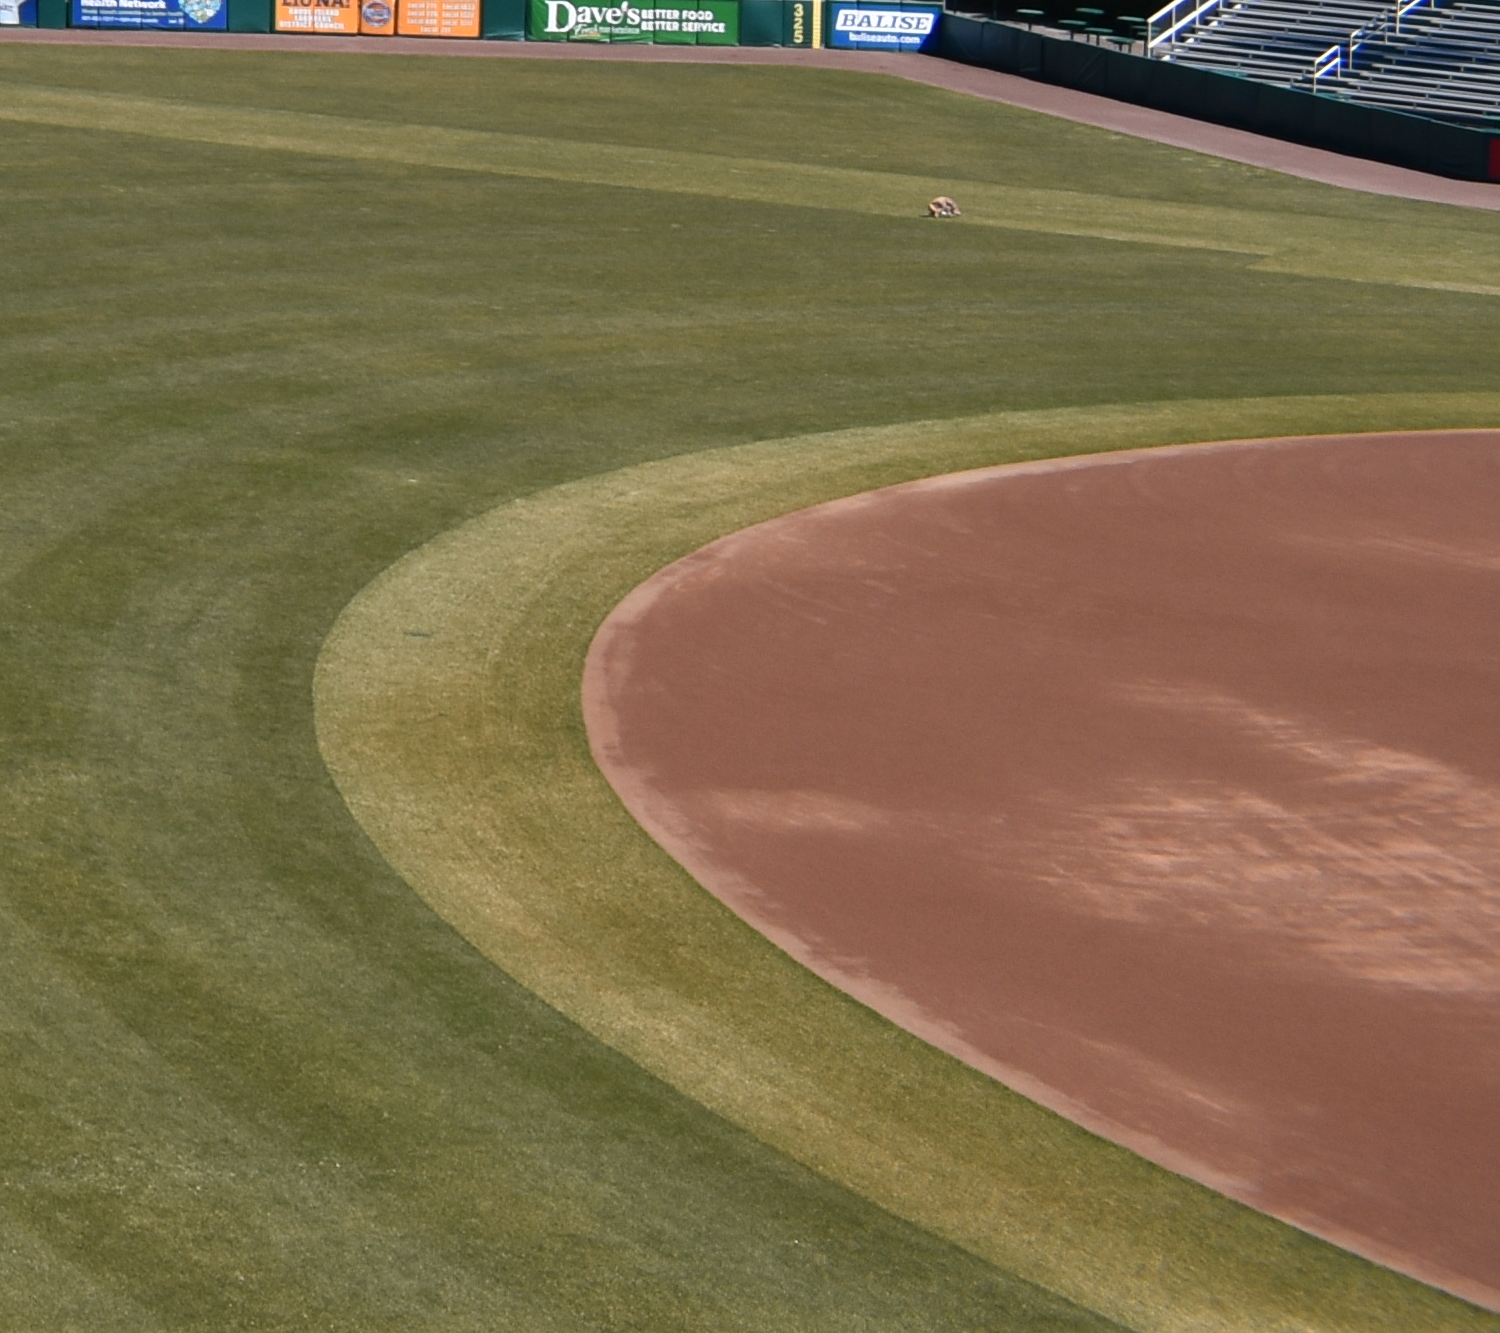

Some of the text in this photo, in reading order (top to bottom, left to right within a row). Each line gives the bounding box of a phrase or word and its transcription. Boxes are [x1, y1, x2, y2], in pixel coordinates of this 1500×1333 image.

[119, 0, 166, 8] Network
[544, 0, 640, 32] Dave's
[641, 9, 679, 20] BETTER
[682, 10, 713, 20] FOOD
[794, 3, 803, 44] 325
[841, 13, 930, 30] BALISE
